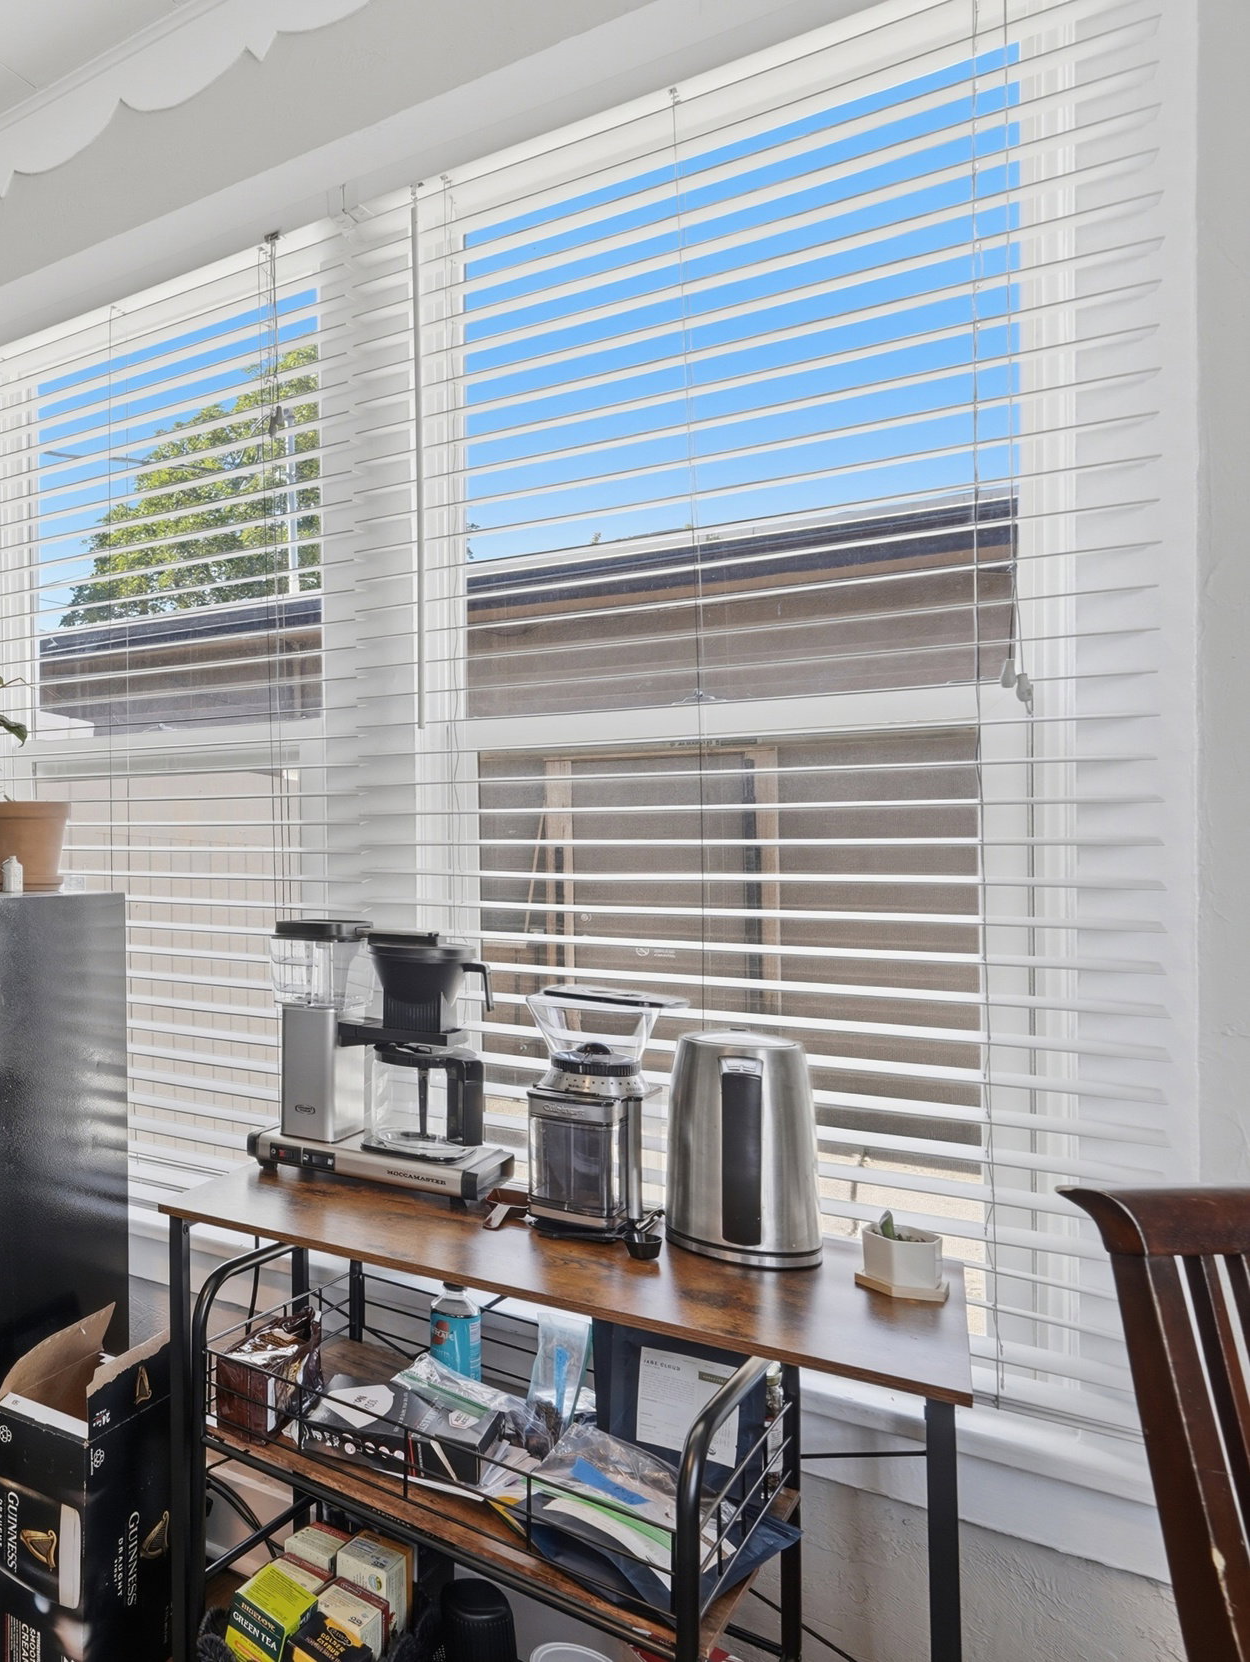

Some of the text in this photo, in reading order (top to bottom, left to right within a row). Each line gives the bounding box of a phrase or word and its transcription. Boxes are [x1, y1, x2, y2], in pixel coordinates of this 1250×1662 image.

[386, 1169, 447, 1185] MOCCAMASTER
[7, 1491, 20, 1573] GUINNESS
[128, 1511, 140, 1606] GUINNESS
[232, 1611, 277, 1652] GREEN TEA
